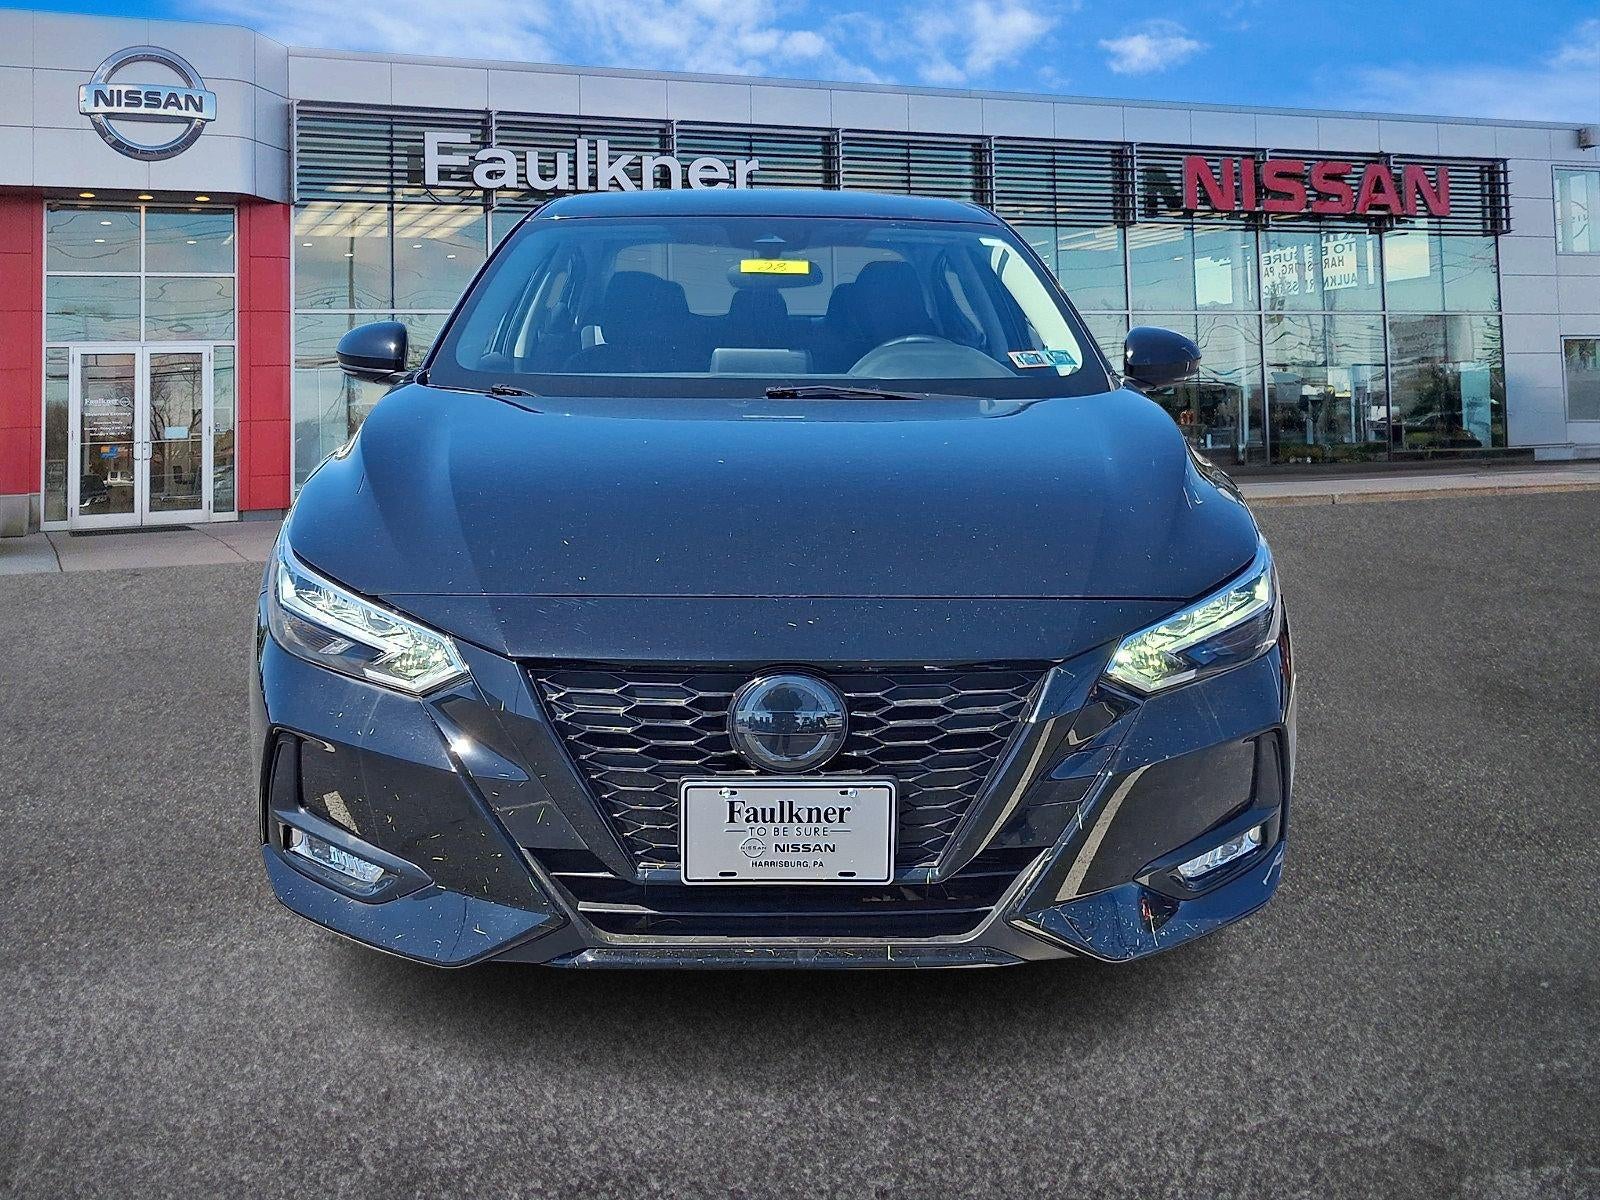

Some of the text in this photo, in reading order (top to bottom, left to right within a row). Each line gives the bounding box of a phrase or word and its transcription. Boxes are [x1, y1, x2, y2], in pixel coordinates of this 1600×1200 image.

[94, 89, 204, 113] NISSAN
[423, 131, 760, 191] Faulkner
[1182, 155, 1450, 216] NISSAN
[725, 800, 851, 824] Faulkner
[748, 827, 829, 837] TO BE SURE
[774, 843, 836, 853] NISSAN
[751, 860, 824, 869] HARRISBURG, PA
